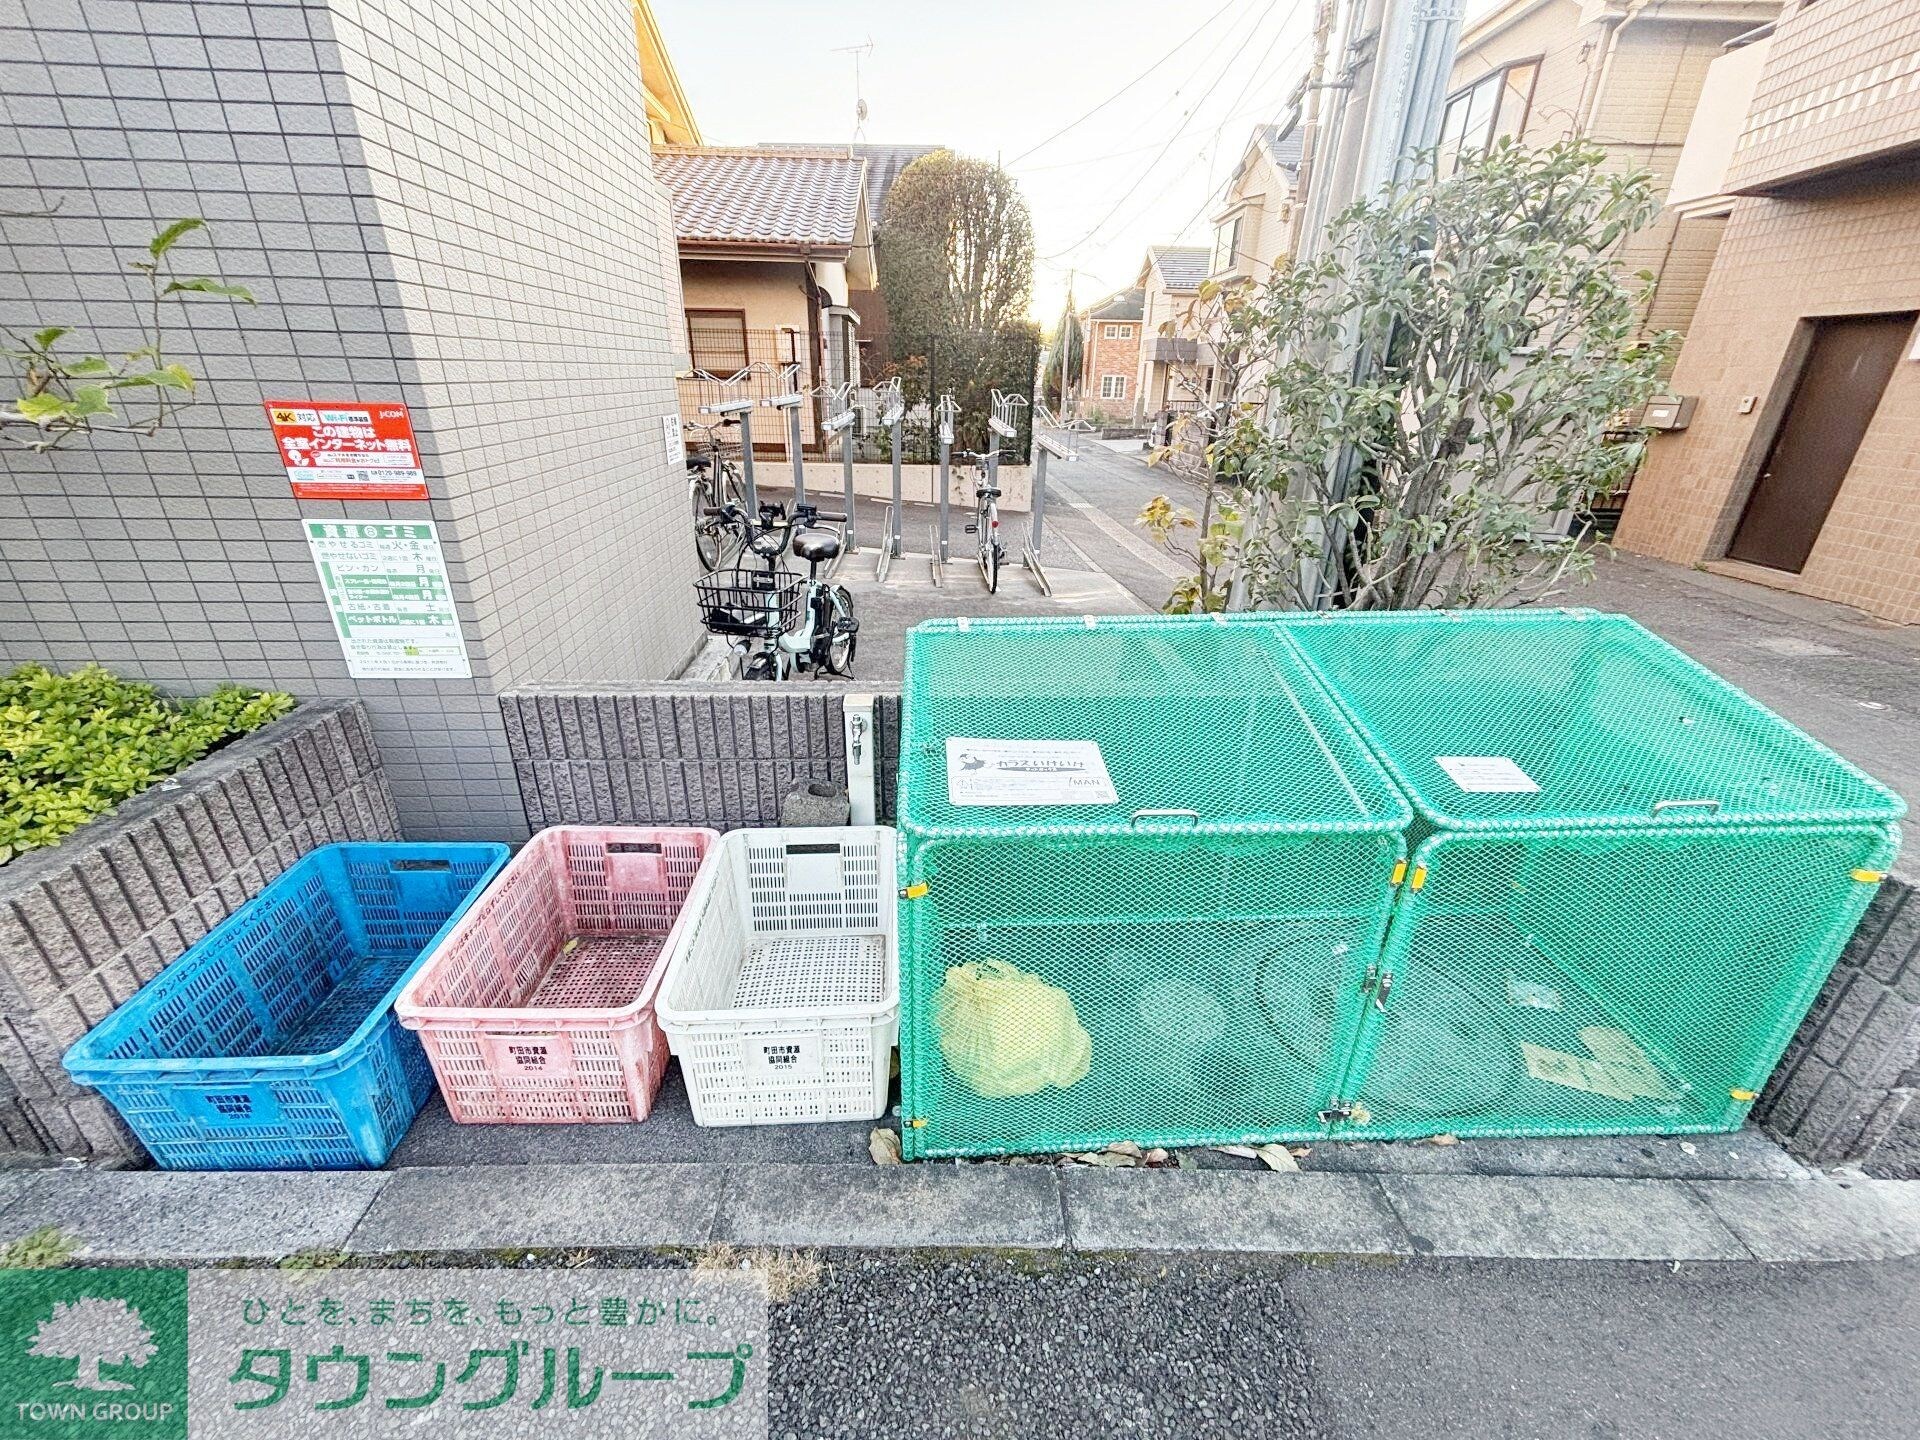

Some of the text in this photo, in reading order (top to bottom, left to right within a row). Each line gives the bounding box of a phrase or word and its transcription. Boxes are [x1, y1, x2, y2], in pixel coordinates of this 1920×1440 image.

[275, 412, 296, 422] 4K
[297, 412, 315, 422] 対応
[324, 412, 348, 422] Wi-Fi
[311, 426, 377, 438] この建物は
[281, 437, 412, 451] 全室インターネット無料
[317, 540, 375, 549] 燃やせるゴミ
[392, 540, 421, 550] 火・金
[321, 552, 378, 560] 燃やせないゴミ
[412, 551, 423, 561] 木
[416, 564, 426, 574] 月
[425, 603, 436, 611] 土
[348, 615, 397, 623] ペットボトル
[428, 614, 440, 625] 木
[156, 897, 278, 1000] カンはつぶして出してください
[509, 1046, 548, 1055] 町田市資源
[763, 1045, 800, 1055] 町田市資源
